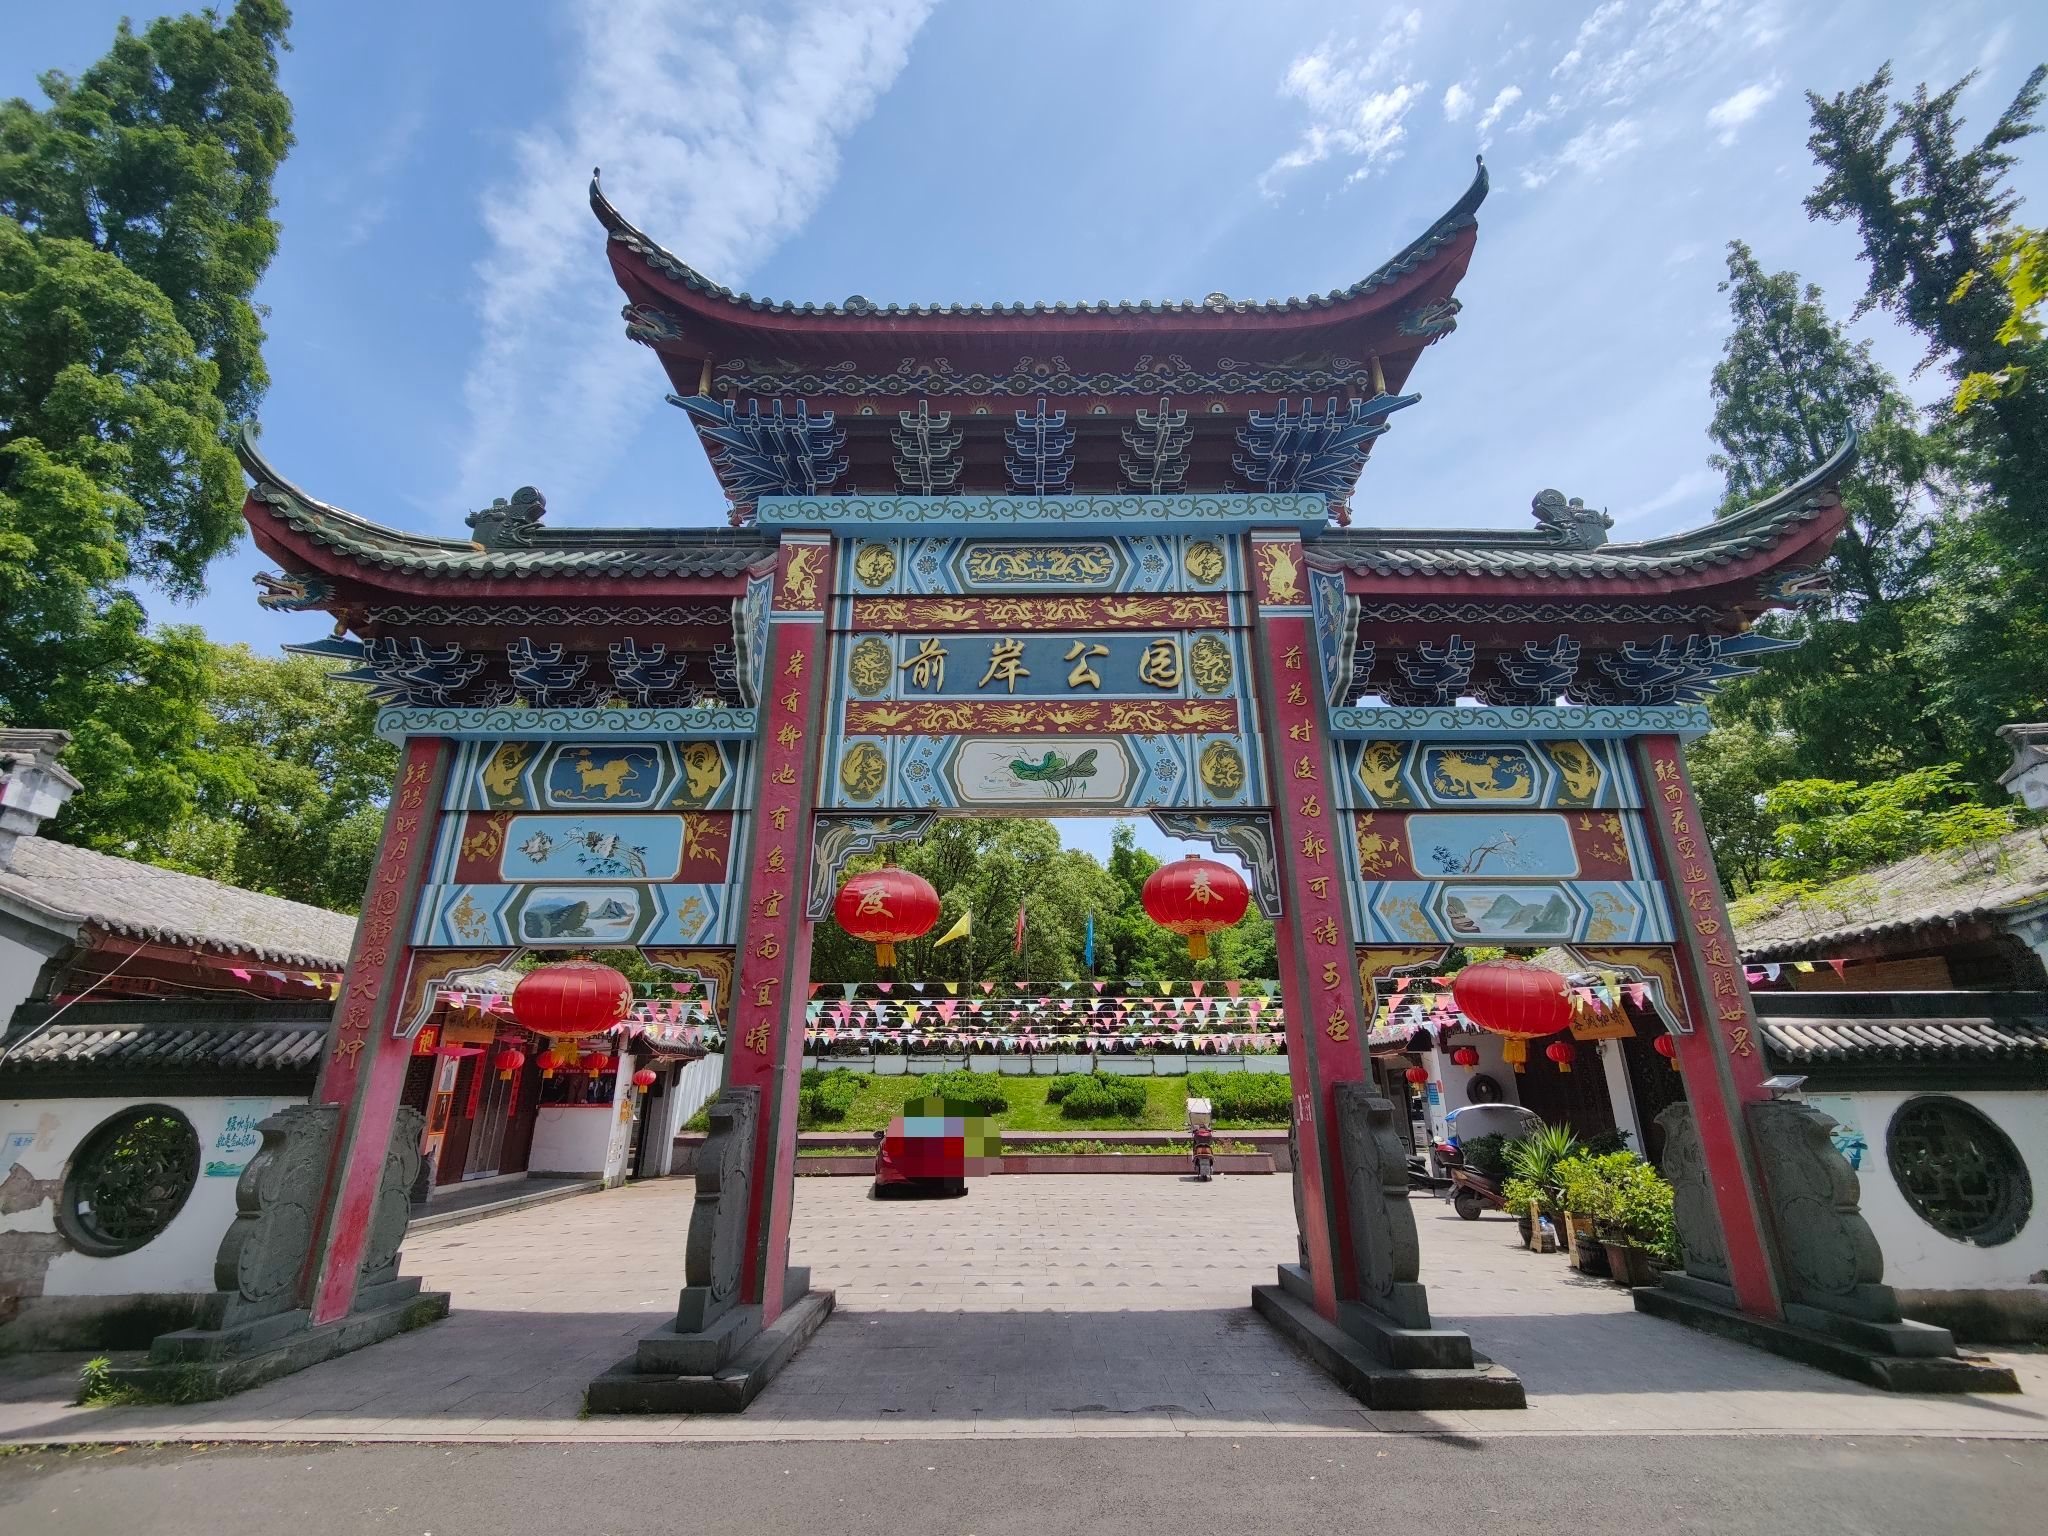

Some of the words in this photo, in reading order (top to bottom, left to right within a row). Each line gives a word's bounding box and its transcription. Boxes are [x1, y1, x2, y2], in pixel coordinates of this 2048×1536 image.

[899, 637, 1183, 694] 前岸公园
[855, 884, 894, 919] 度
[1185, 867, 1224, 904] 春
